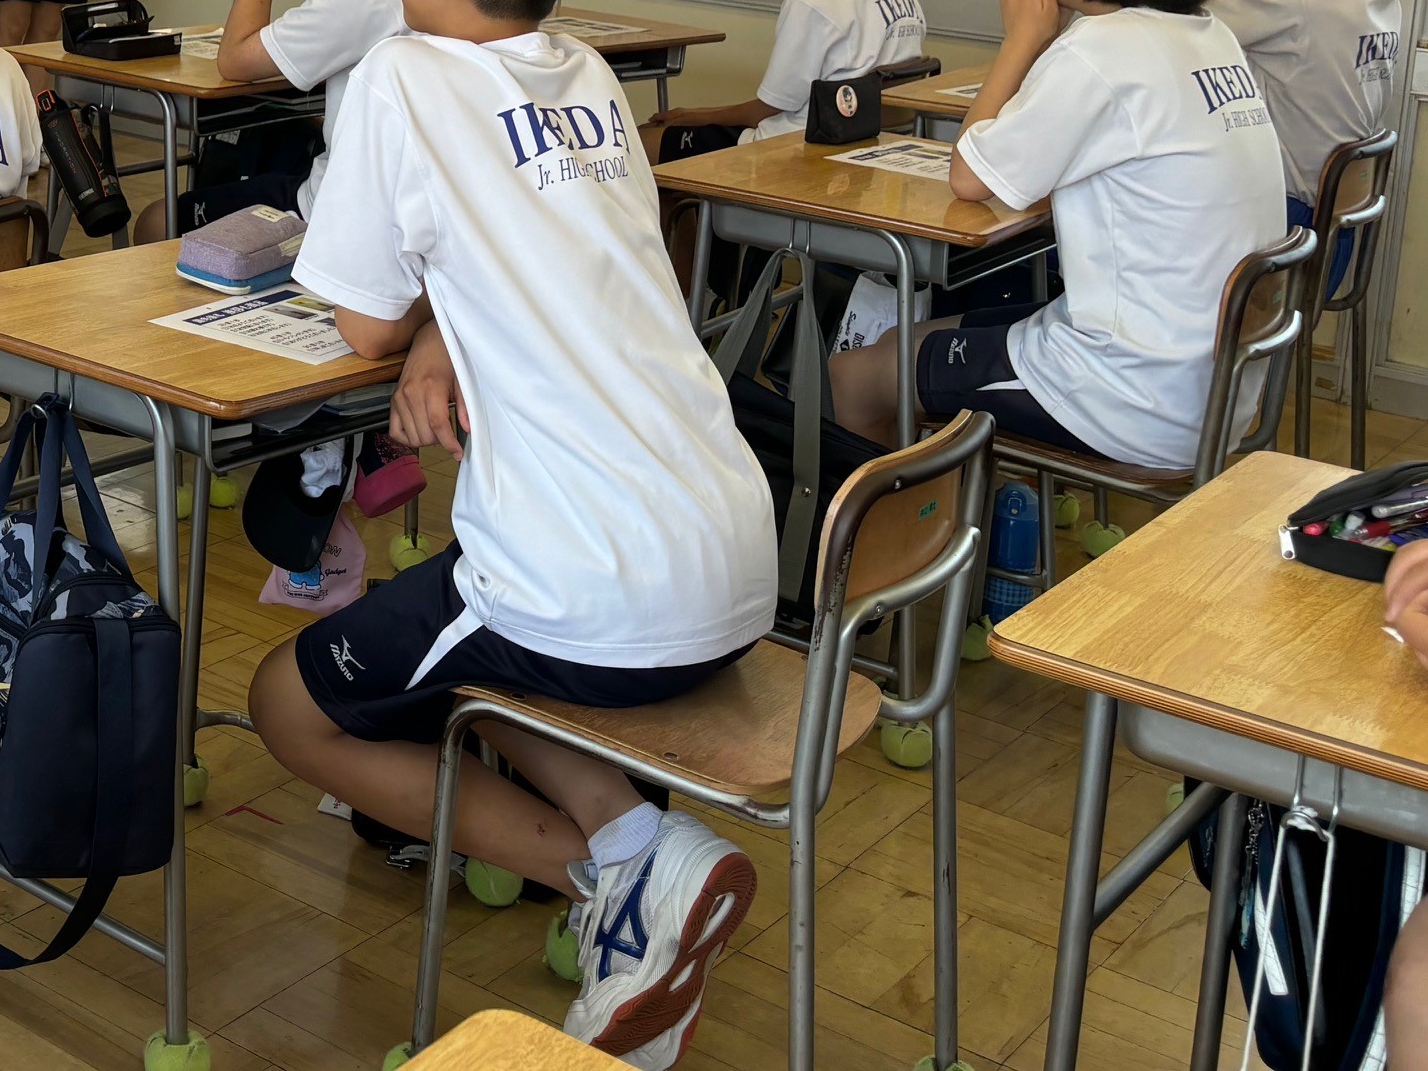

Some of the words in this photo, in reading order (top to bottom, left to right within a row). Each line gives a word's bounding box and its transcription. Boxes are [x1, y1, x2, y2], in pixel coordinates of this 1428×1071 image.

[538, 164, 555, 191] Jr.
[325, 568, 347, 577] Gadget
[330, 643, 354, 681] MIZUNO
